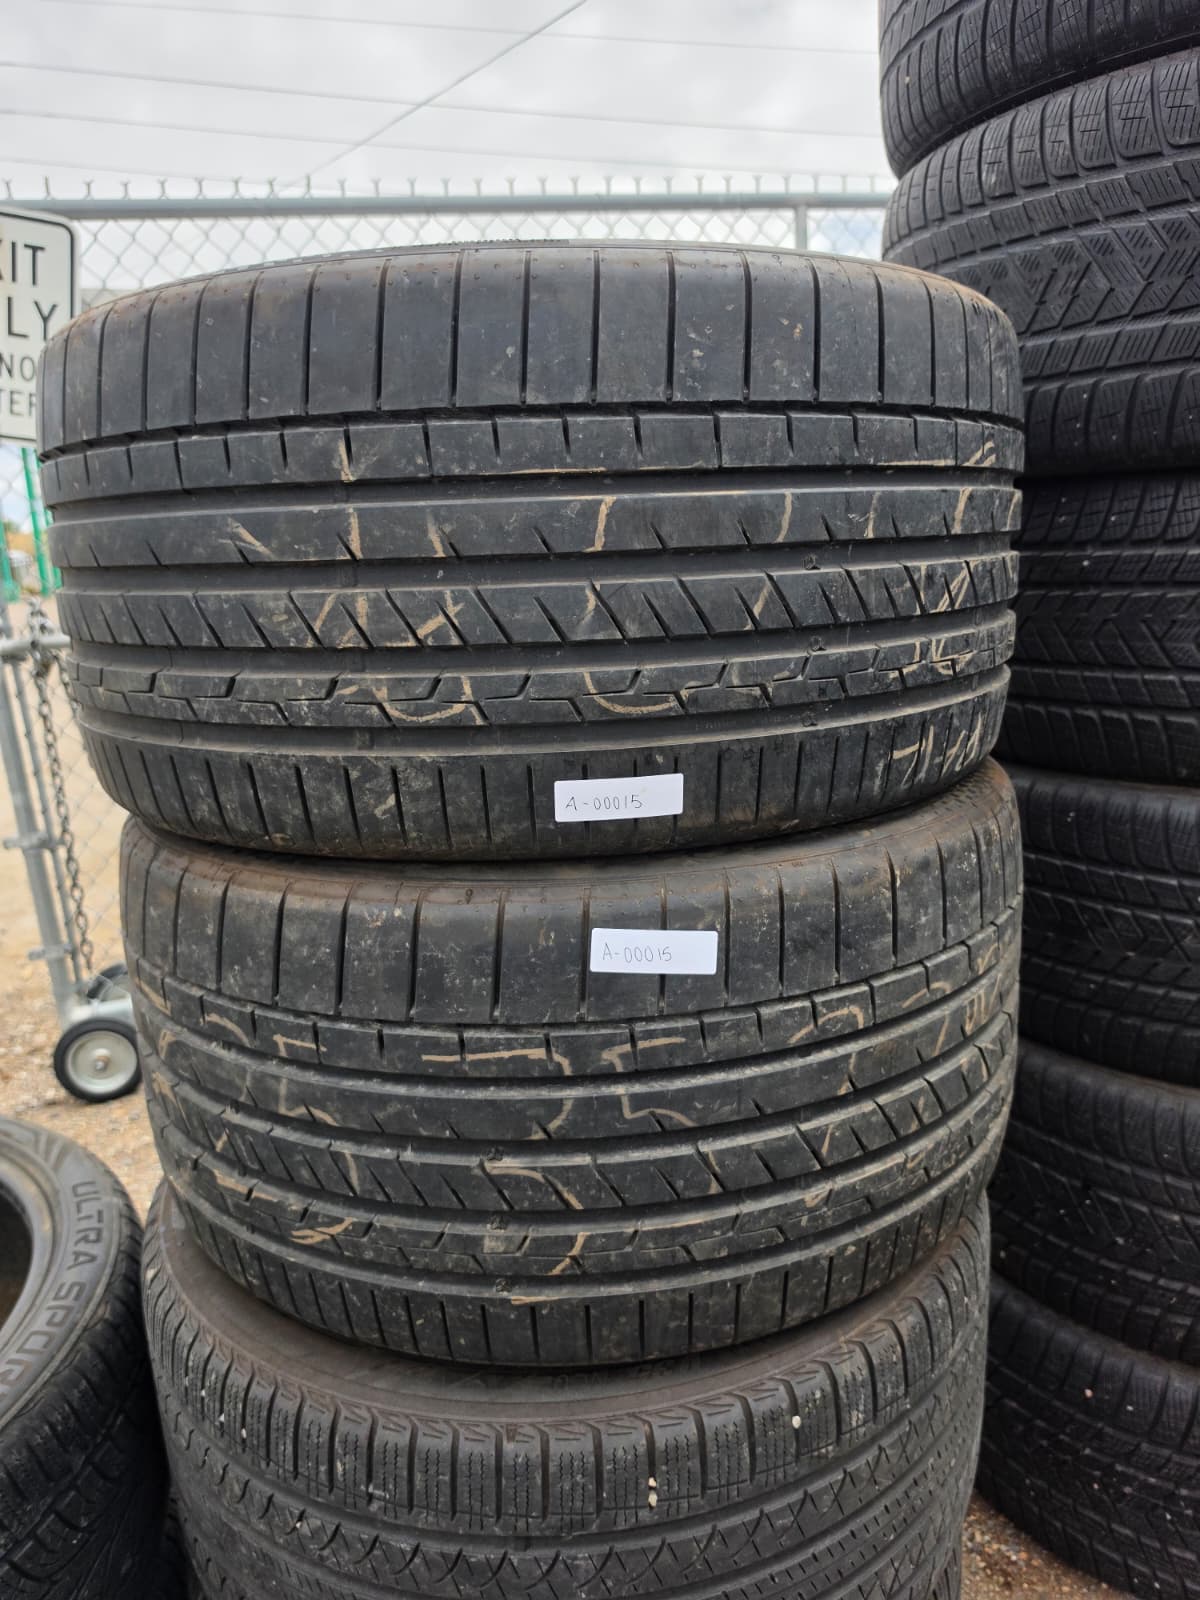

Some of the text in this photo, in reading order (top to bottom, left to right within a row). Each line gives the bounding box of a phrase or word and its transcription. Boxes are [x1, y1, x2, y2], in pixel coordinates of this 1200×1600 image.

[0, 239, 46, 286] IT
[565, 794, 643, 811] A-00015
[602, 942, 672, 964] A-00015
[0, 1181, 104, 1397] ULTRA SPOR
